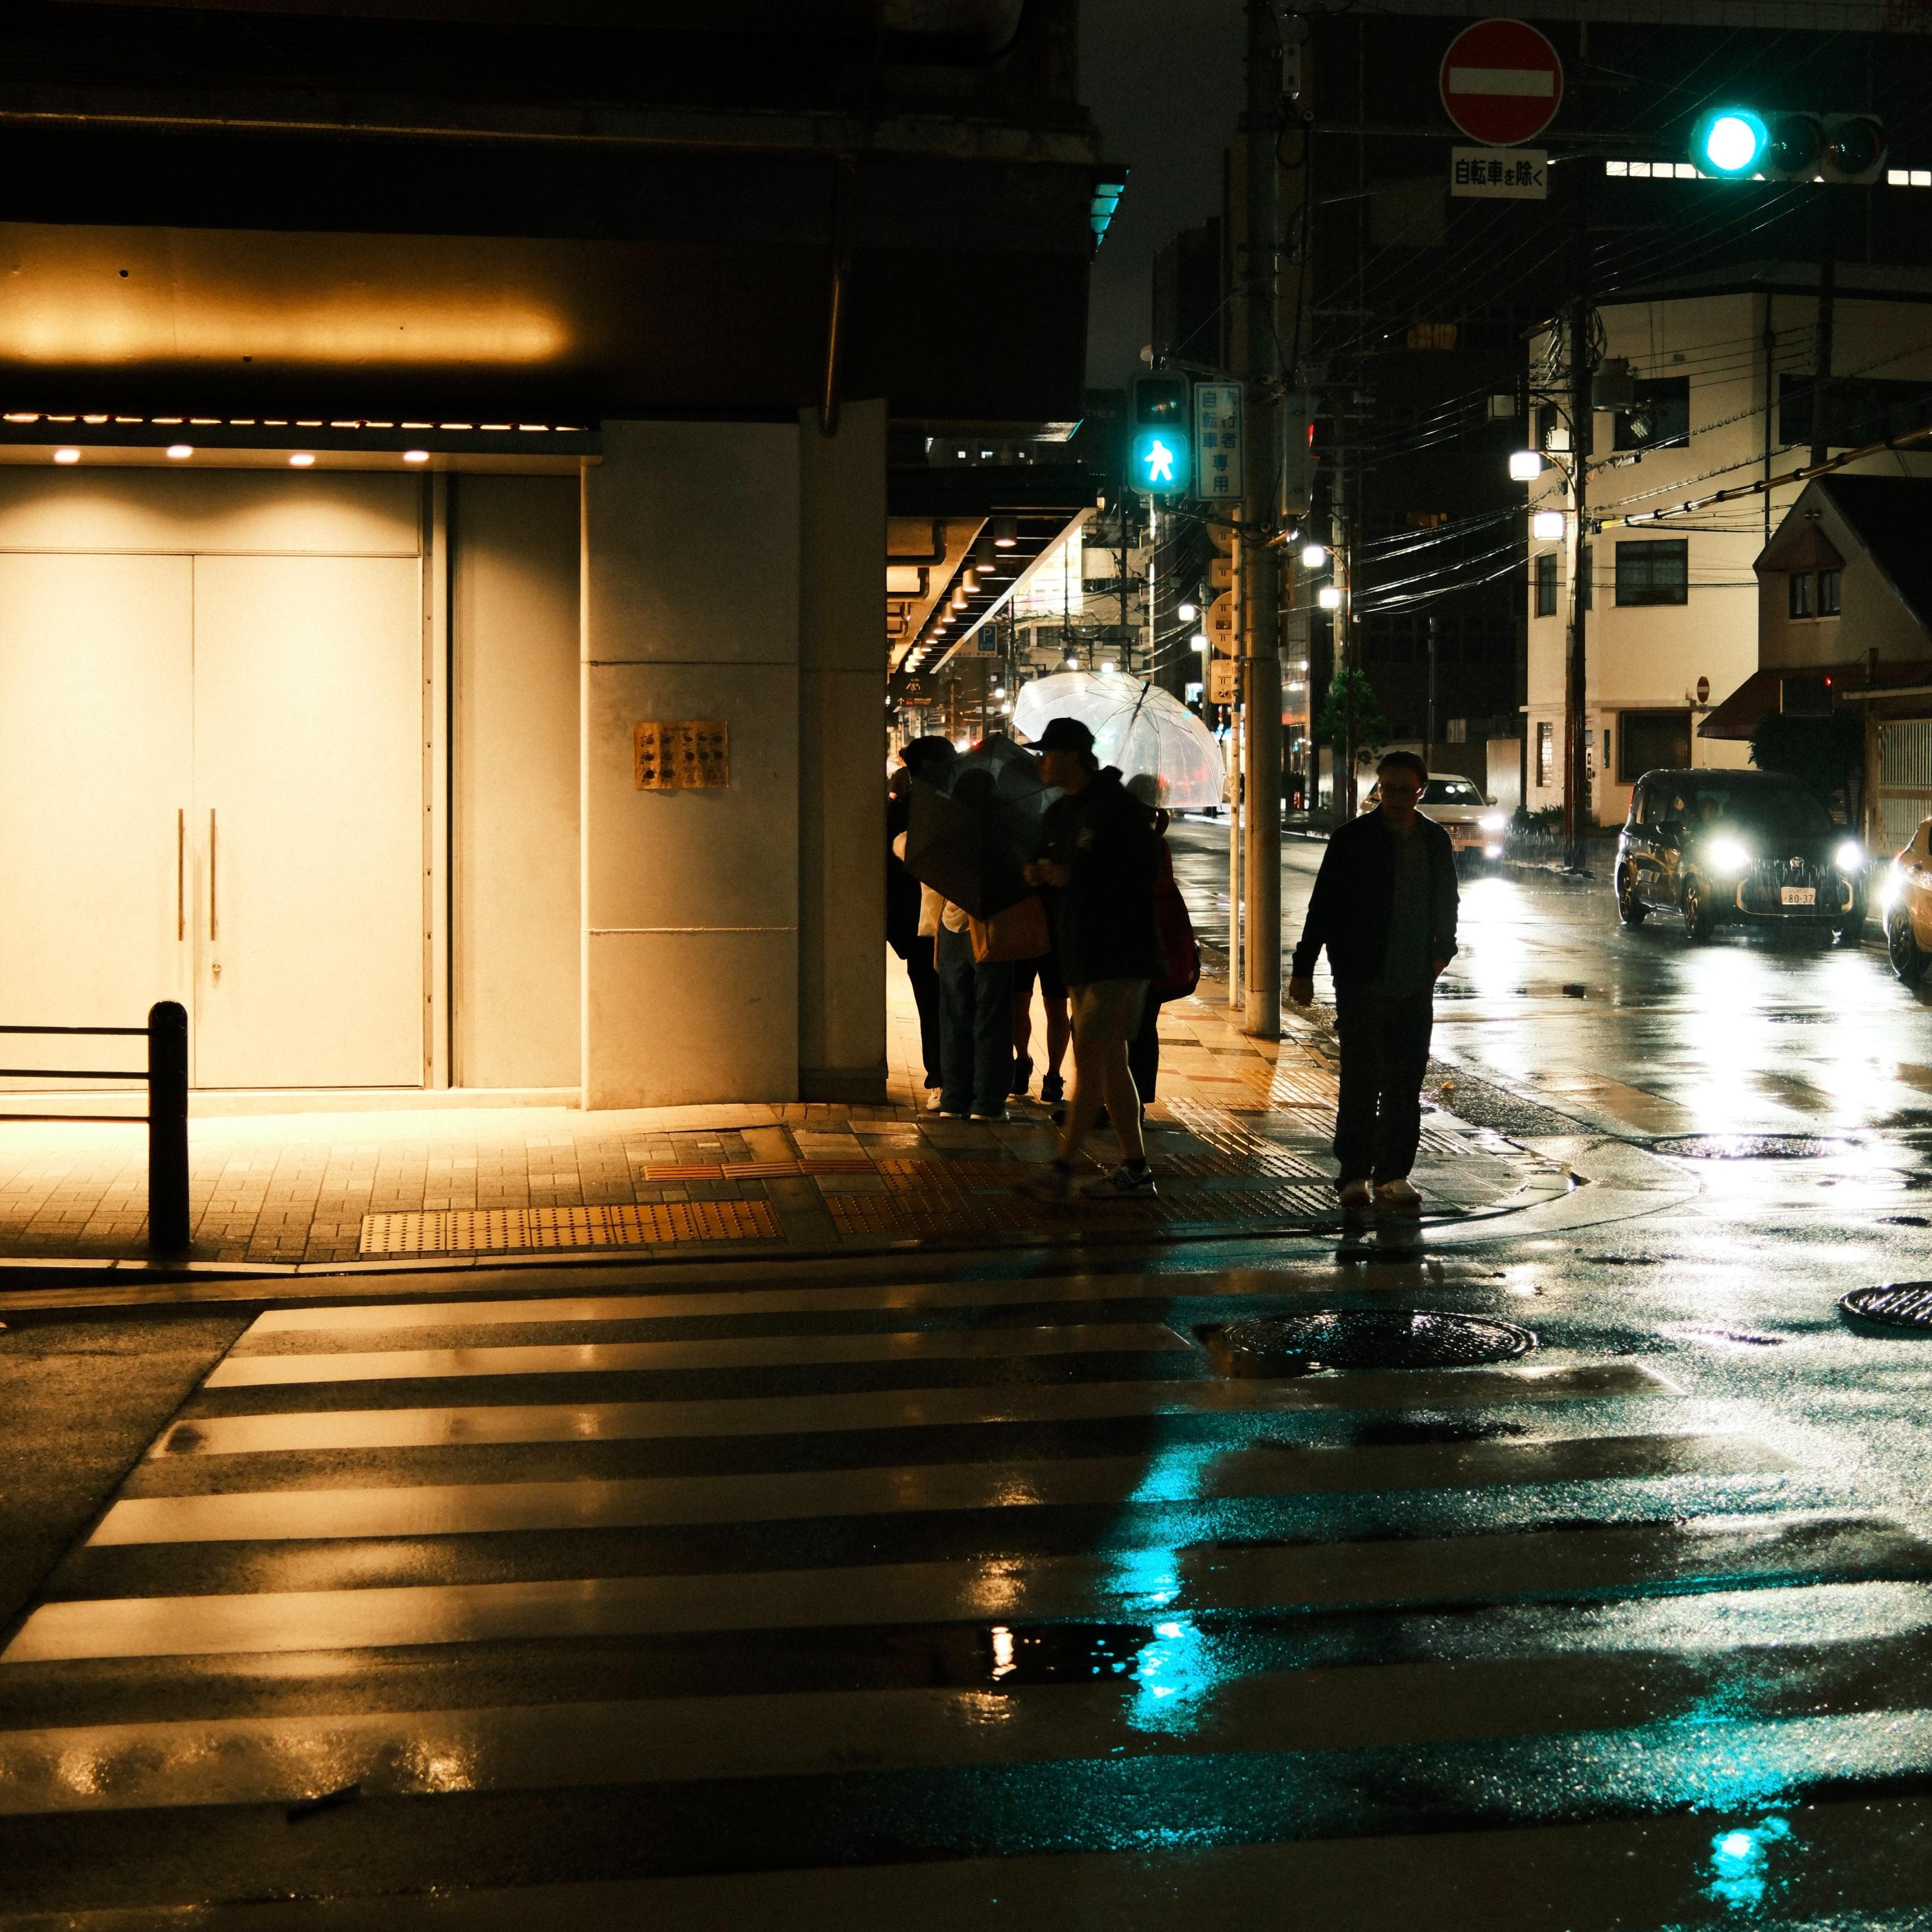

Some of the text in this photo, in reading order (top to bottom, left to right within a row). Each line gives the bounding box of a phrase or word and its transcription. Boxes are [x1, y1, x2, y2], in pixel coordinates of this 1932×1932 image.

[1455, 158, 1543, 187] 自転車を除く
[1201, 391, 1218, 449] 自転車
[1212, 453, 1229, 493] 専用
[983, 627, 992, 642] P
[1789, 894, 1814, 903] 80-37
